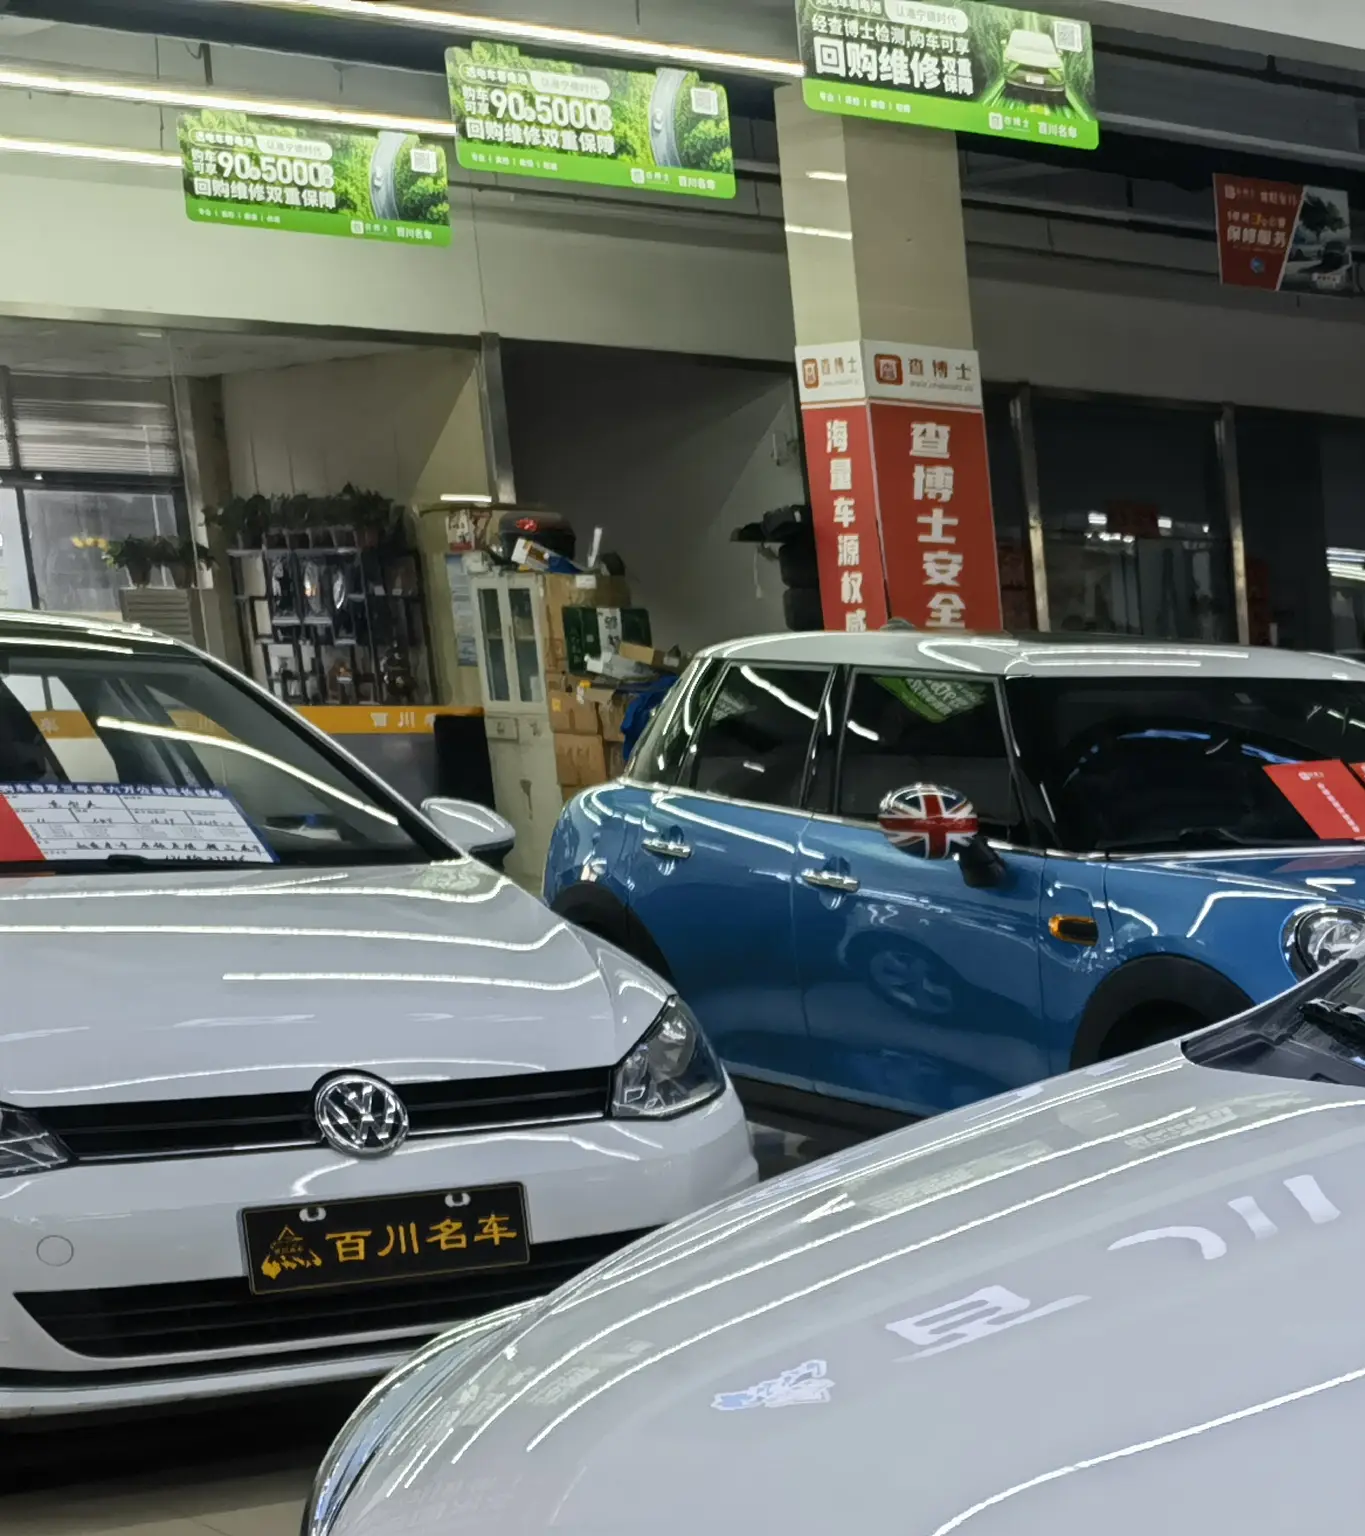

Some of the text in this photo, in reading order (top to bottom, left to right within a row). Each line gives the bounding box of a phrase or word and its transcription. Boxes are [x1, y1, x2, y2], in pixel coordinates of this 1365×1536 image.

[813, 36, 942, 90] 回购维修
[466, 119, 615, 154] 回购维修双重保障
[909, 422, 967, 629] 查博士安全
[325, 1211, 518, 1263] 百川名车
